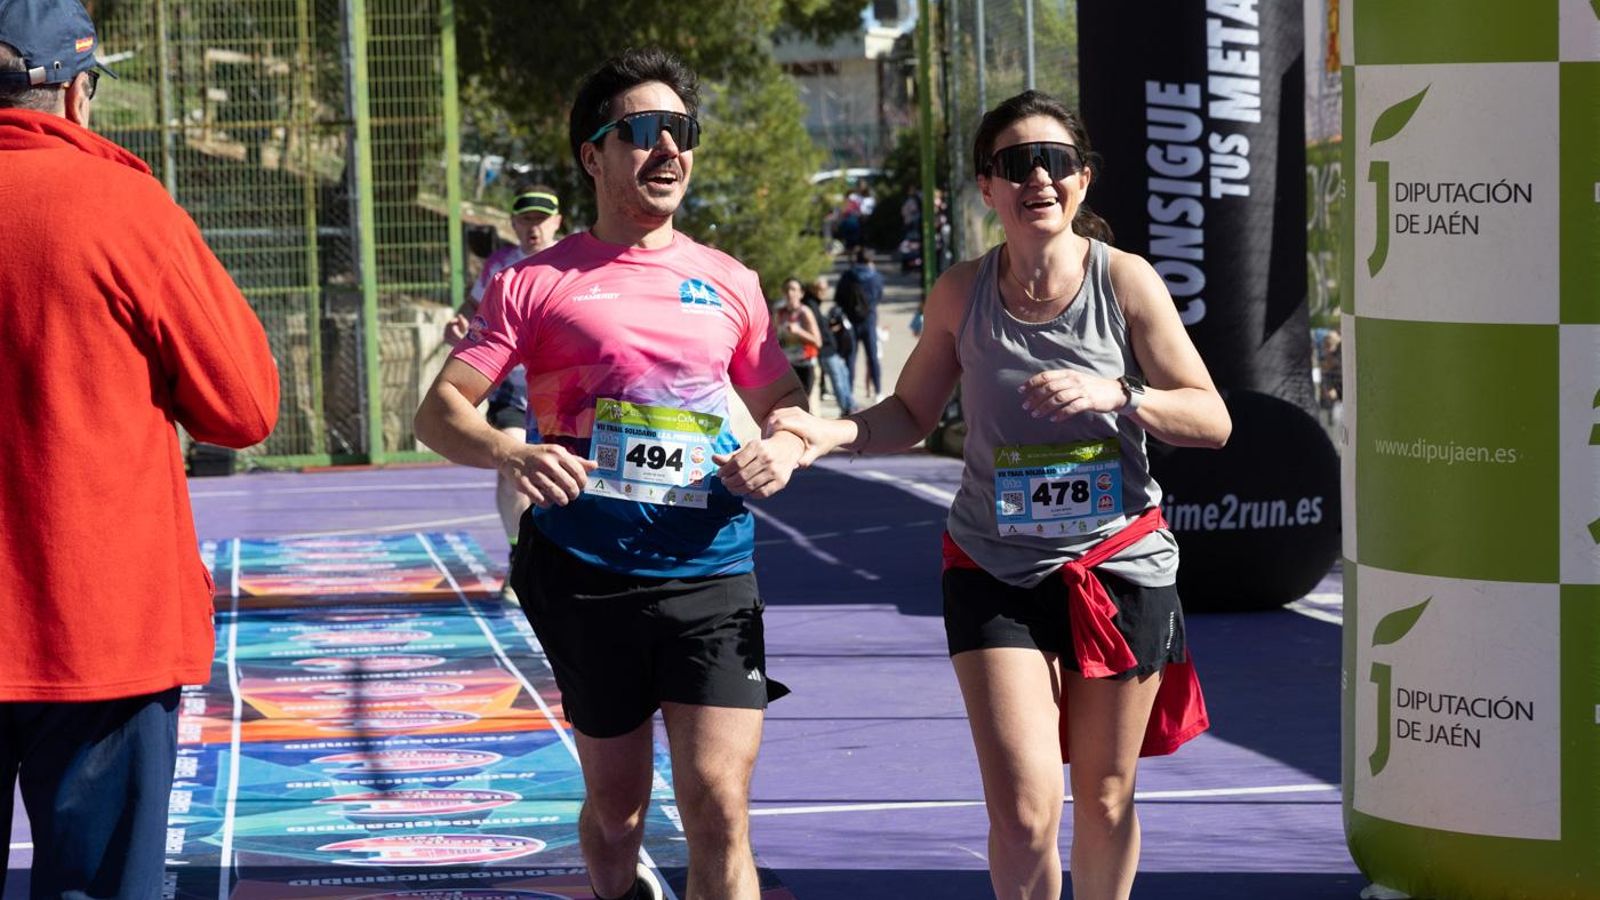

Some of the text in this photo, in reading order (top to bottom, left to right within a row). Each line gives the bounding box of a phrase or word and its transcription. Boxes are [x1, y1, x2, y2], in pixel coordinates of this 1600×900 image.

[1206, 0, 1261, 199] TUS META
[1145, 79, 1207, 326] CONSIGUE
[1395, 178, 1533, 205] DIPUTACIÓN
[1395, 210, 1480, 236] DE JAÉN
[624, 427, 657, 438] SOLIDARIO
[626, 443, 683, 472] 494
[1375, 437, 1517, 466] www.dipujaen.es
[1032, 480, 1090, 506] 478
[1165, 493, 1323, 531] ime2run.es
[1396, 688, 1534, 721] DIPUTACIÓN
[1396, 720, 1481, 749] DE JAÉN
